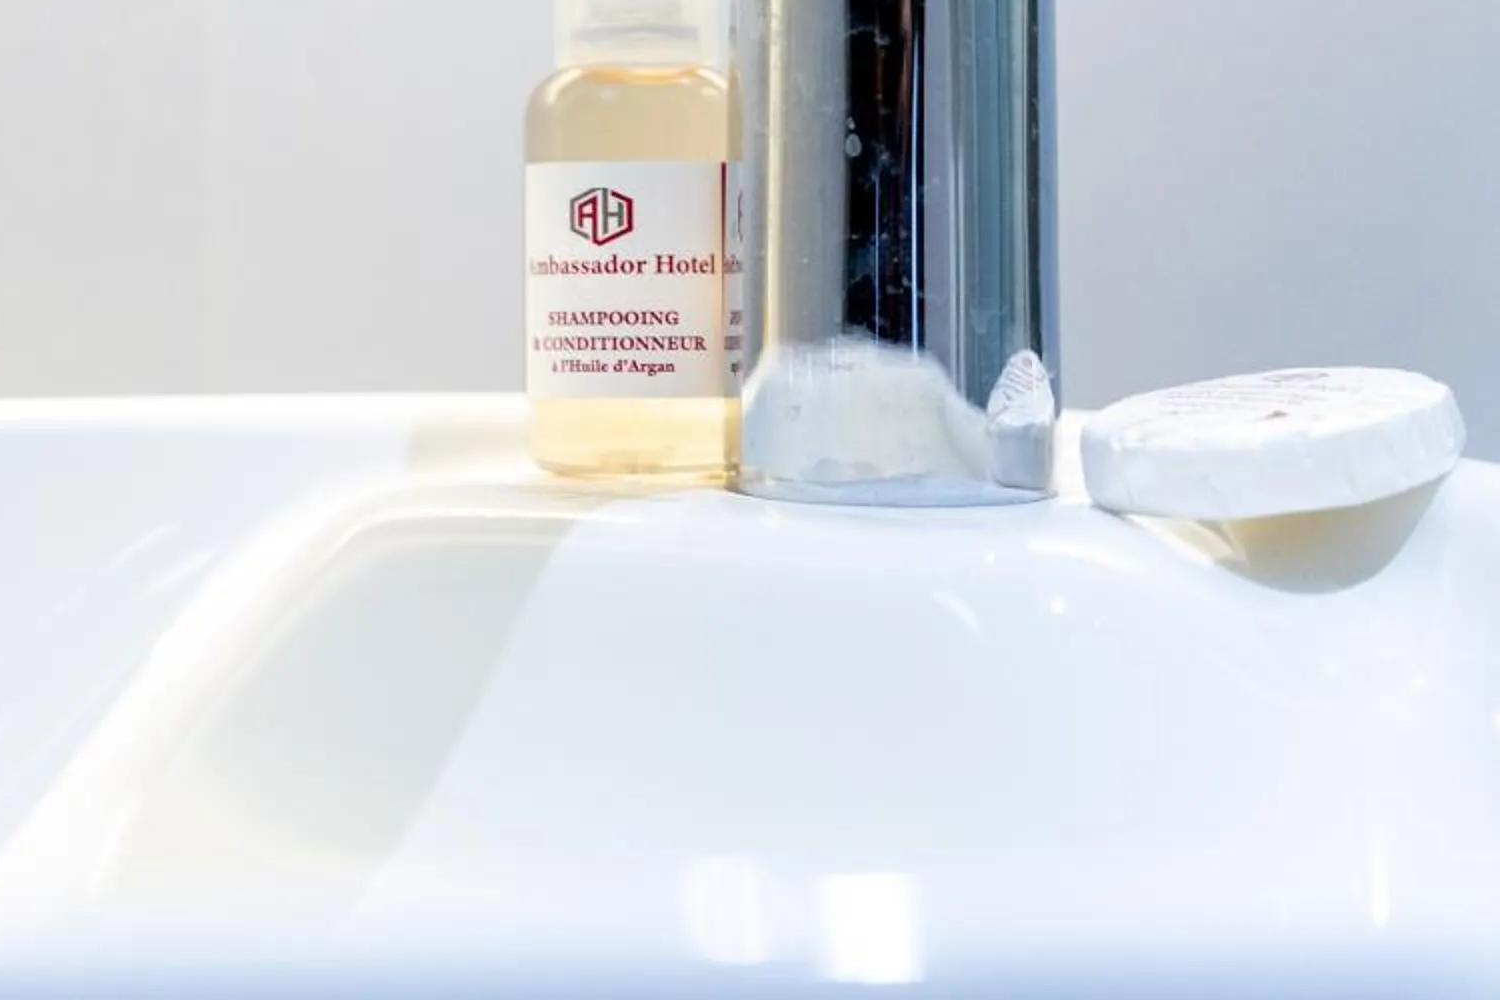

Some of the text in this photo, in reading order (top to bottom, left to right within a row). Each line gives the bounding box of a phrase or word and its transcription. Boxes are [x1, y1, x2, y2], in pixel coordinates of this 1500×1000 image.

[655, 253, 715, 274] Hotel
[549, 310, 680, 326] SHAMPOOING
[543, 335, 707, 351] CONDITIONNEUR
